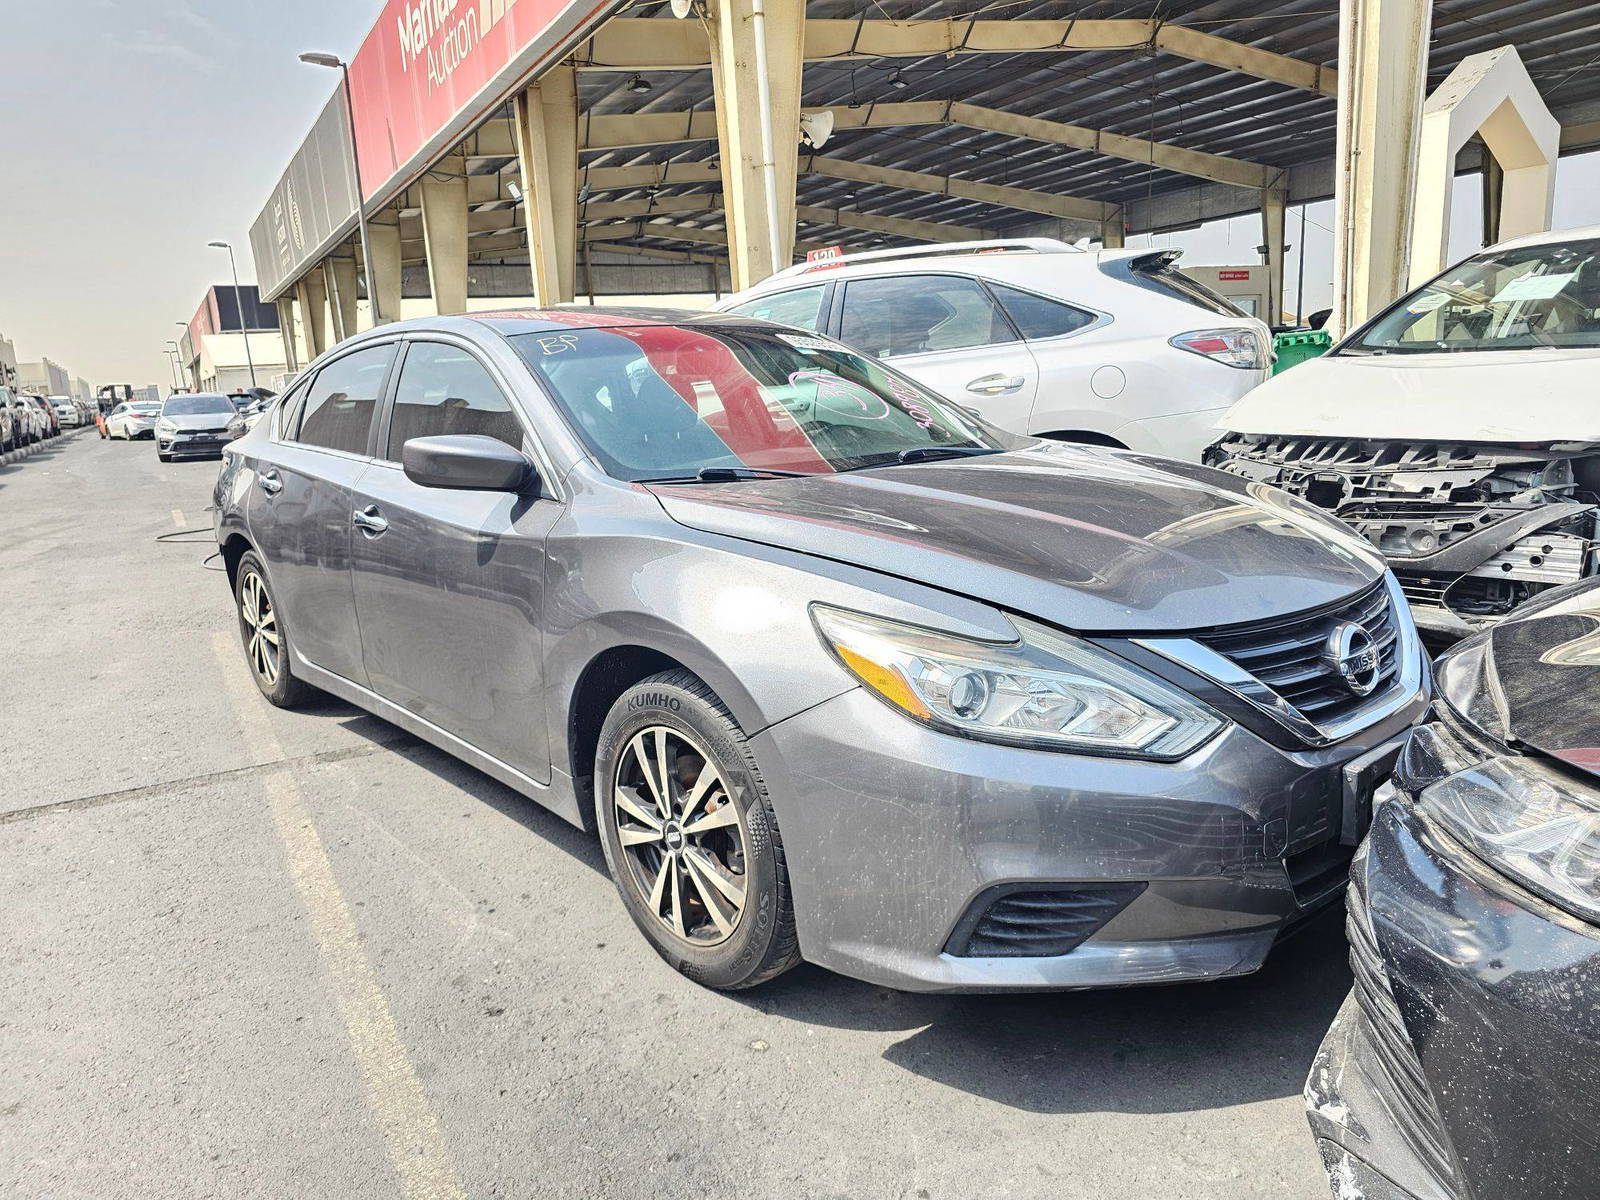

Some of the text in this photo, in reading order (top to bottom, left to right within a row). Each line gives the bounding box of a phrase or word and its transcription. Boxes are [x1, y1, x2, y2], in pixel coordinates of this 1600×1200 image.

[427, 7, 479, 97] Auction
[536, 334, 579, 356] BP
[627, 692, 681, 712] KUMHO
